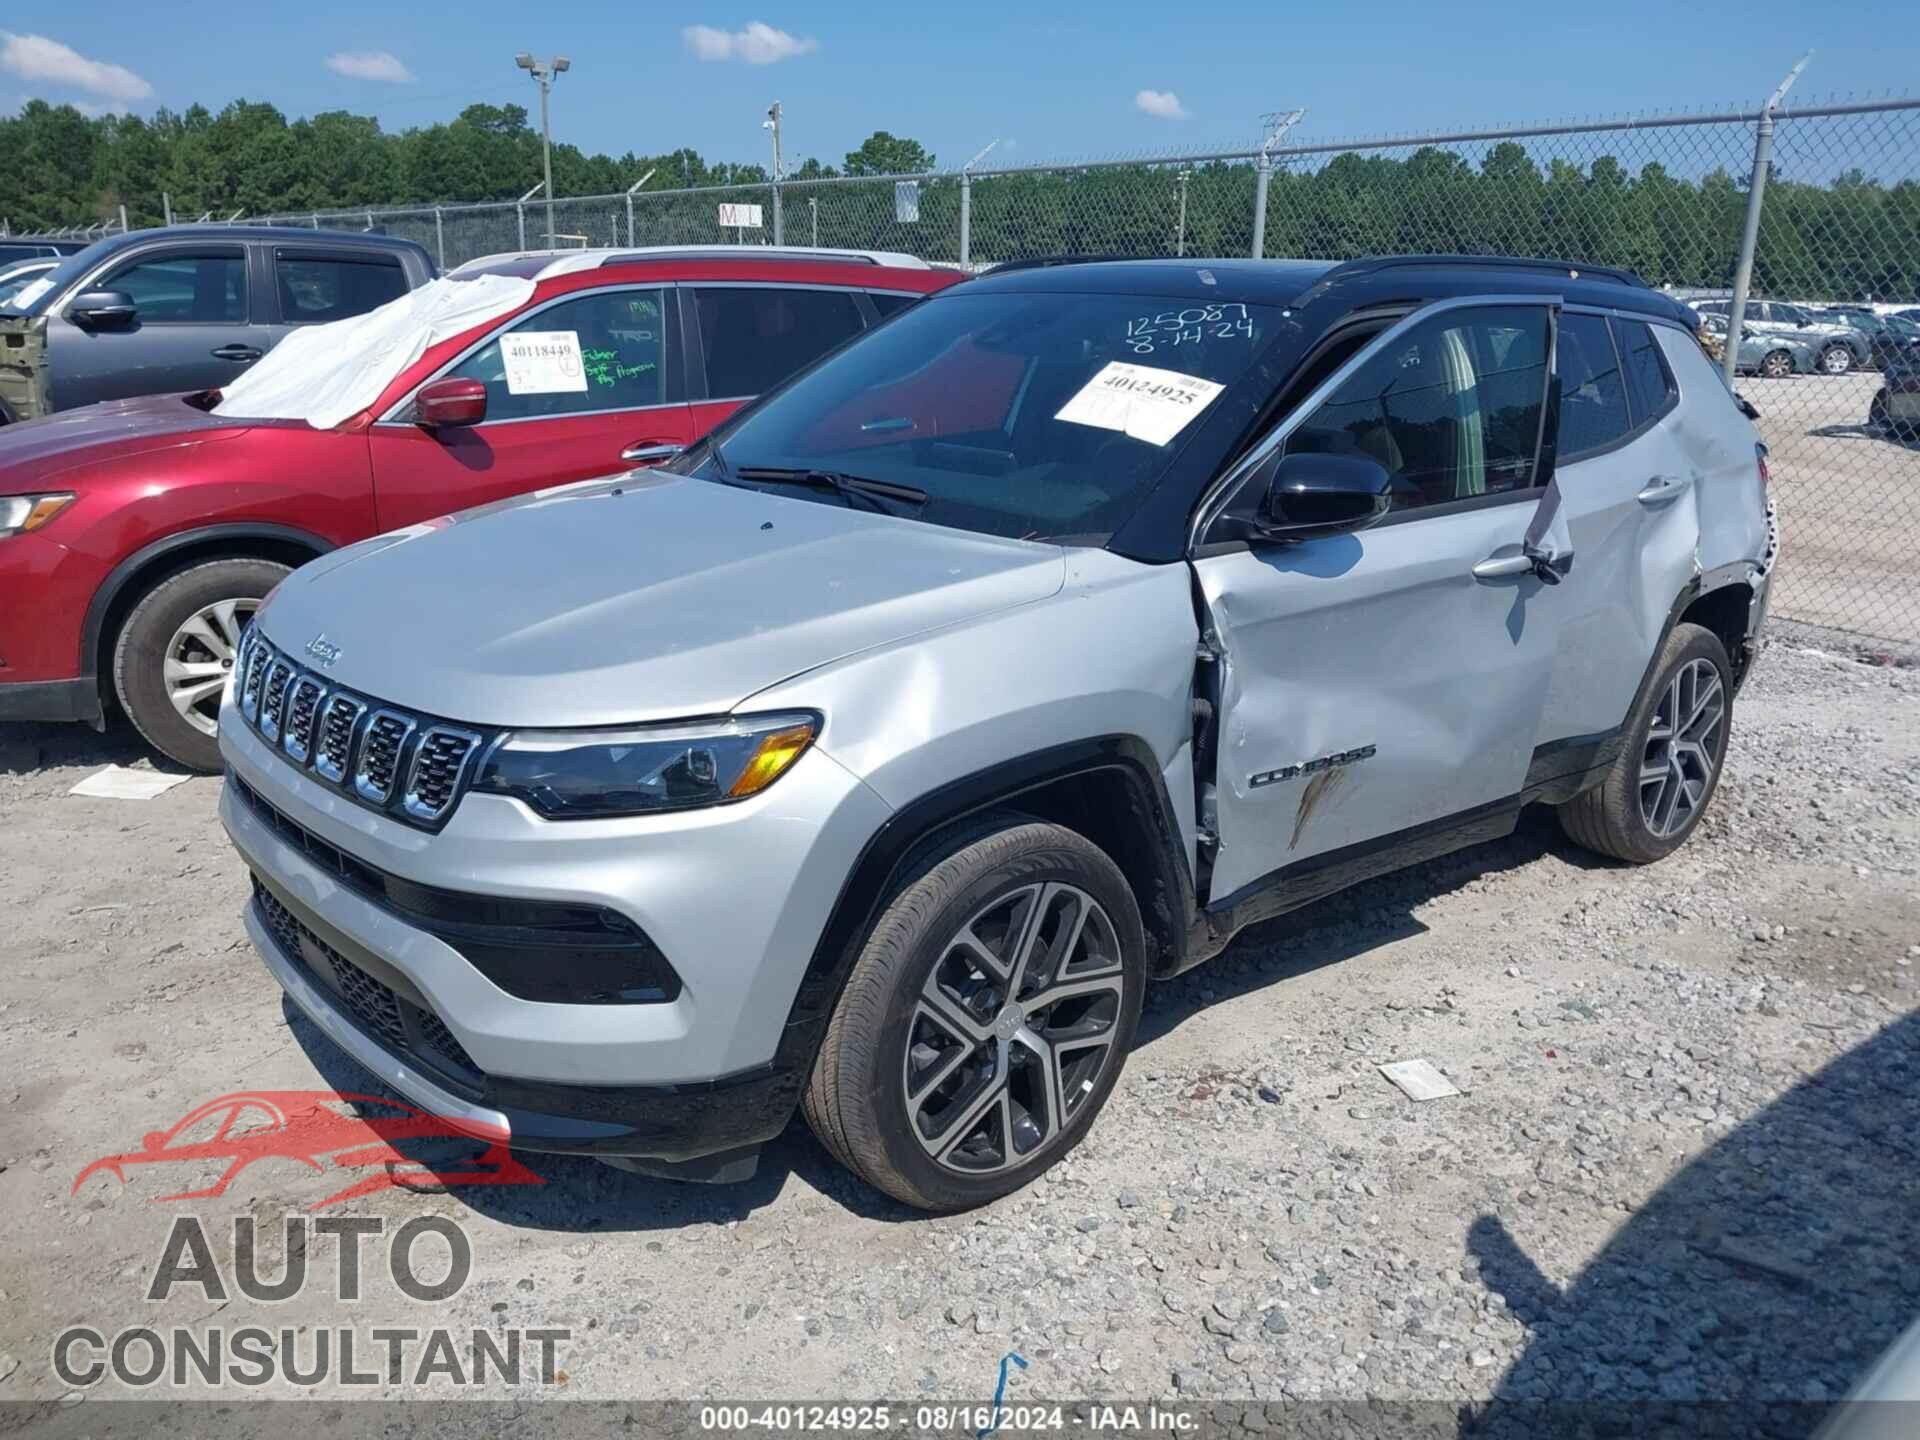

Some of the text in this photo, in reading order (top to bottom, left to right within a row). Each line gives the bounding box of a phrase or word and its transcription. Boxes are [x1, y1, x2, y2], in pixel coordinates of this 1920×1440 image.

[511, 344, 572, 357] 40118449
[1103, 374, 1200, 405] 40124925
[304, 632, 343, 669] Jeep
